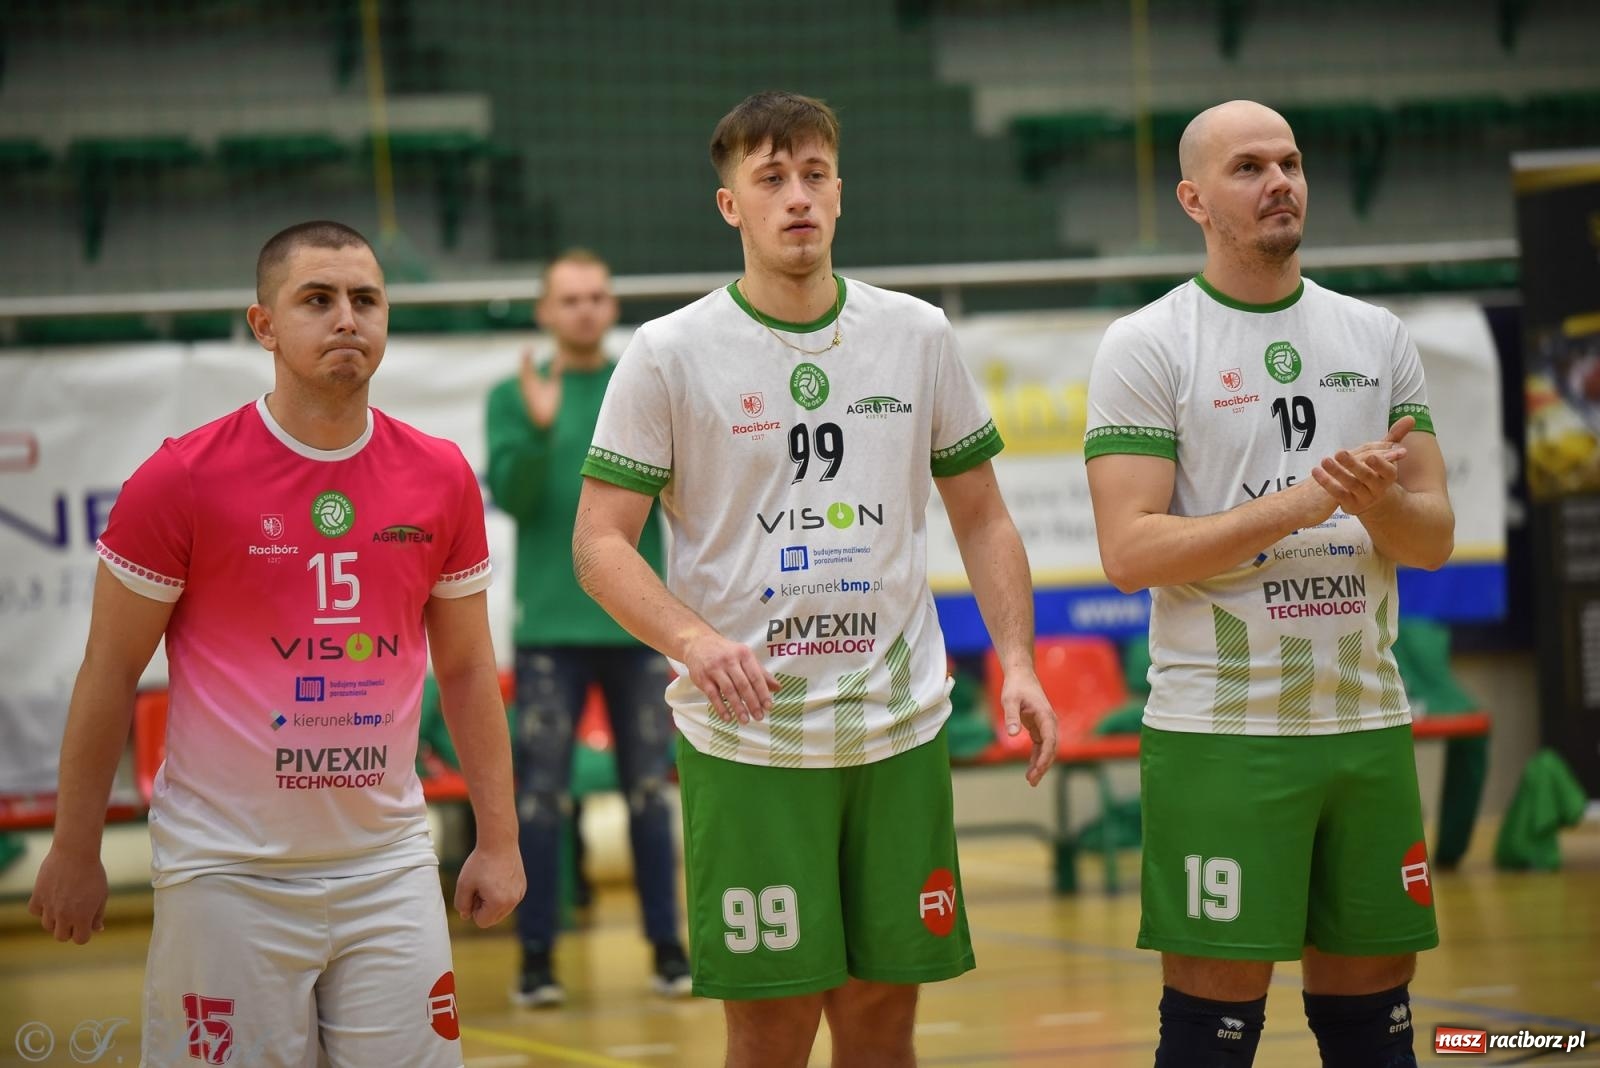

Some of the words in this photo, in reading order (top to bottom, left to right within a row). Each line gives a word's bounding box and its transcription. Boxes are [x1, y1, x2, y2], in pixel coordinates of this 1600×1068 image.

[1213, 394, 1260, 408] Racibórz
[732, 420, 781, 435] Racibórz
[1271, 396, 1317, 453] 19
[788, 422, 844, 485] 99
[757, 502, 884, 534] VISON
[249, 544, 299, 555] Racibórz
[1273, 543, 1367, 561] kierunekbmp.pl
[307, 551, 361, 611] 15
[781, 578, 883, 597] kierunekbmp.pl
[1262, 574, 1366, 604] PIVEXIN
[1267, 600, 1367, 620] TECHNOLOGY
[766, 612, 877, 642] PIVEXIN
[271, 632, 399, 662] VISON
[767, 638, 876, 657] TECHNOLOGY
[294, 710, 395, 728] kierunekbmp.pl
[275, 745, 387, 773] PIVEXIN
[276, 772, 385, 790] TECHNOLOGY
[1184, 854, 1242, 922] 19
[721, 885, 801, 954] 99
[182, 993, 235, 1066] 15
